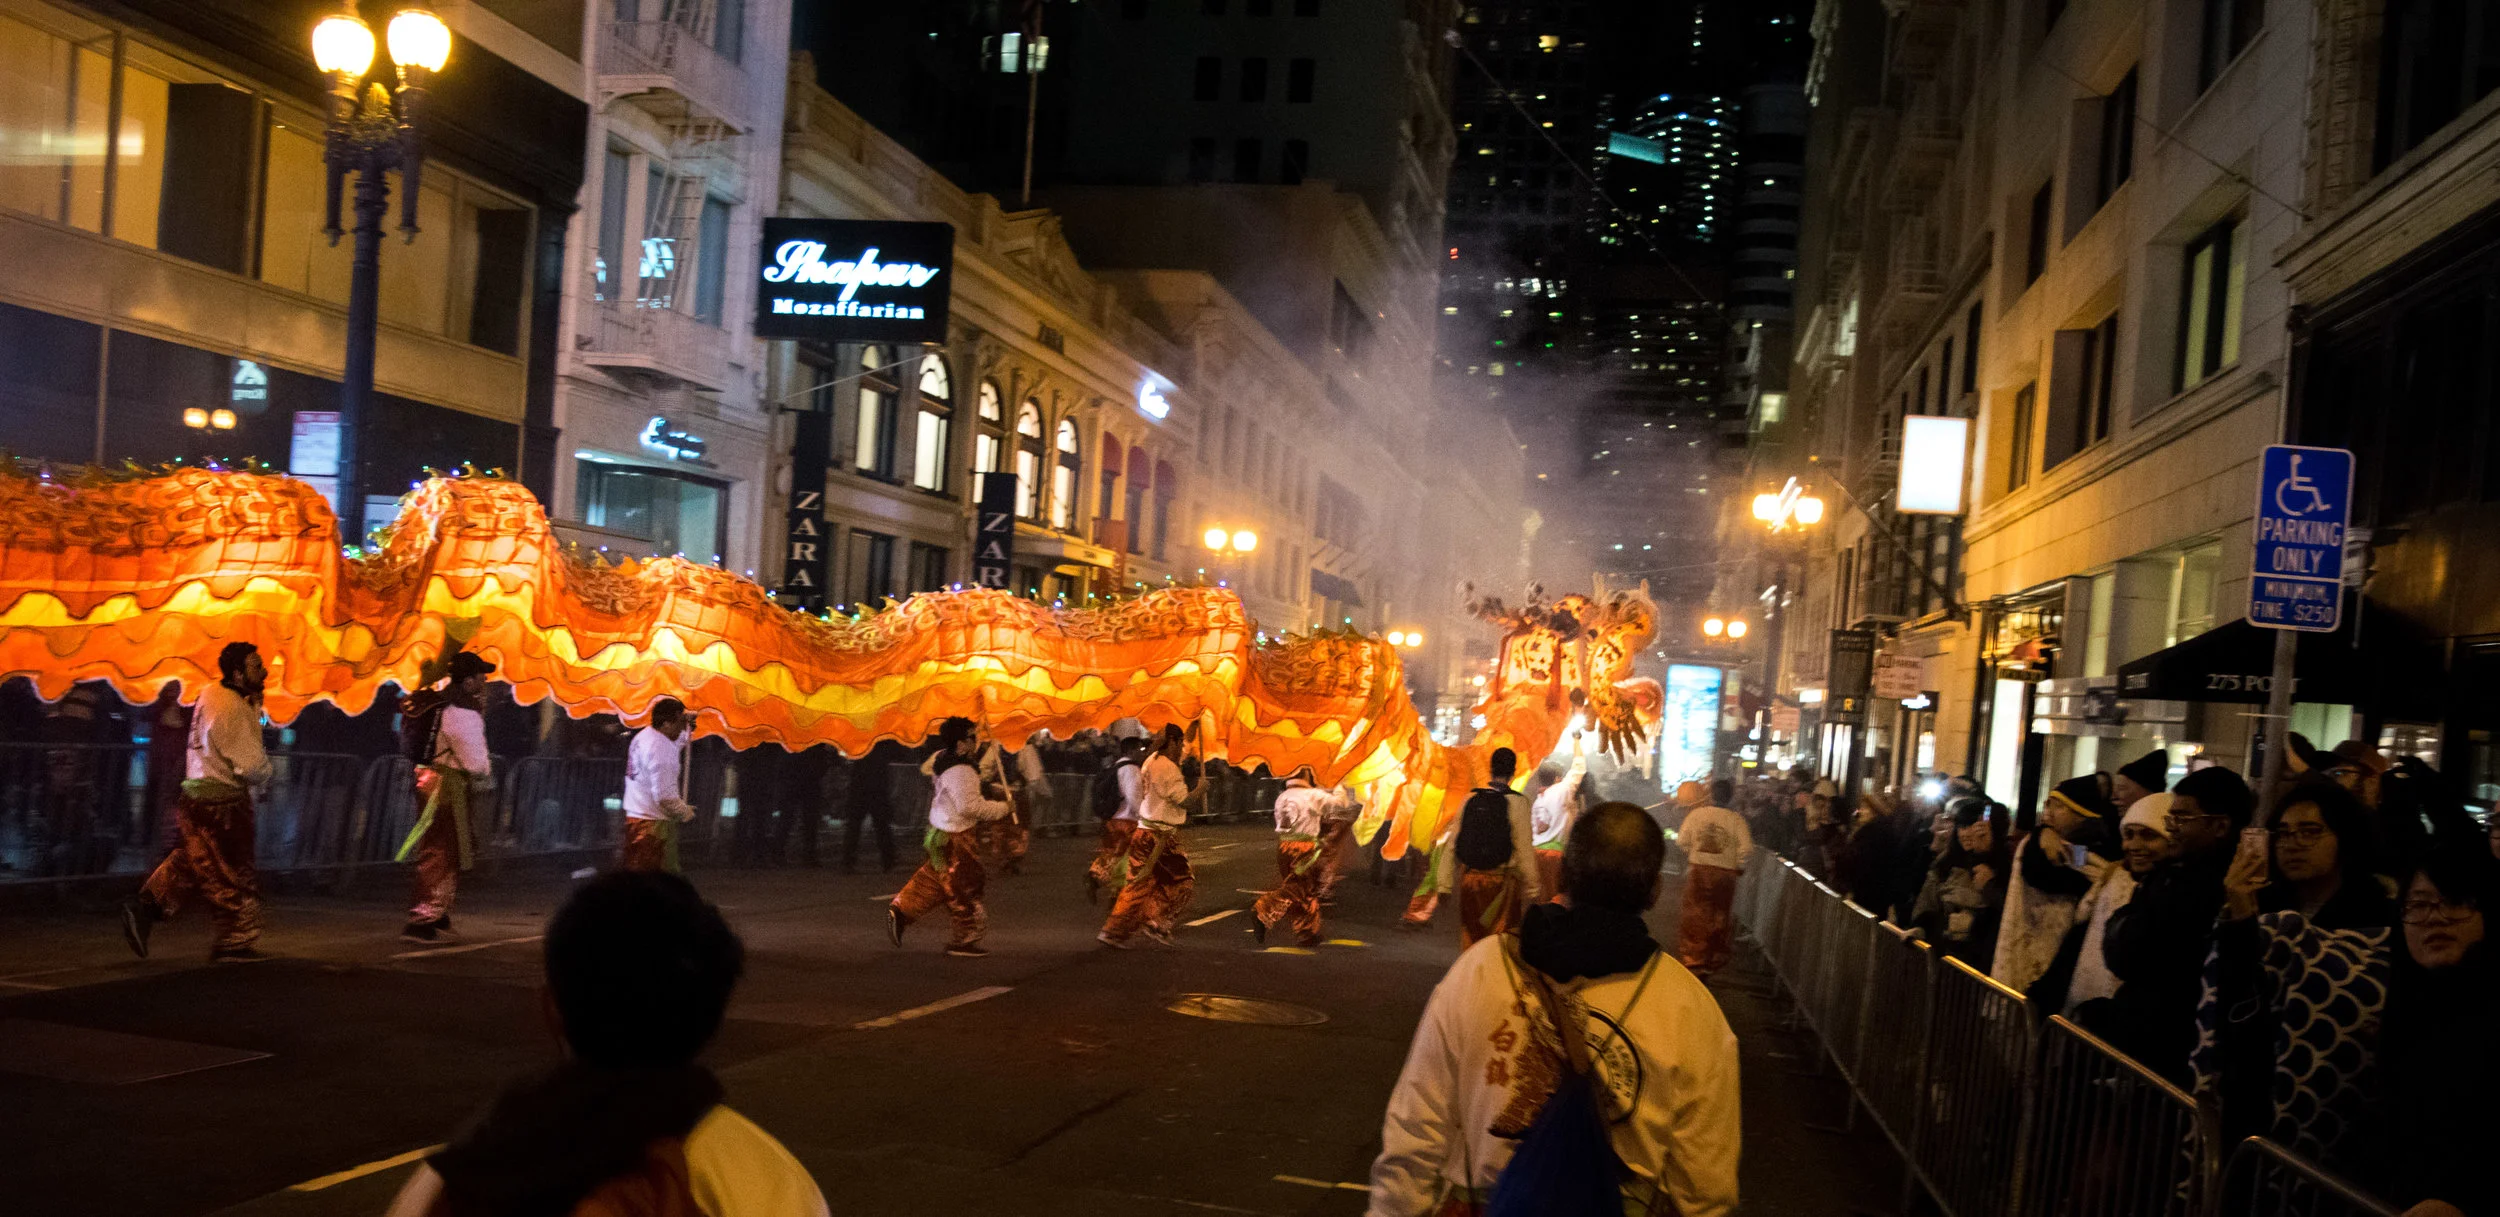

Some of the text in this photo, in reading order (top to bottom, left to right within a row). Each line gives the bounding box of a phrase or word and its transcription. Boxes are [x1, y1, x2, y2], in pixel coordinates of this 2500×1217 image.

[763, 240, 940, 301] Shapur
[772, 298, 925, 320] Mozaffarian
[788, 491, 821, 587] ZARA
[2259, 517, 2343, 547] PARKING
[979, 512, 1009, 587] ZAR
[2272, 546, 2325, 574] ONLY
[2252, 601, 2285, 619] FINE
[2206, 673, 2302, 694] 275 POT
